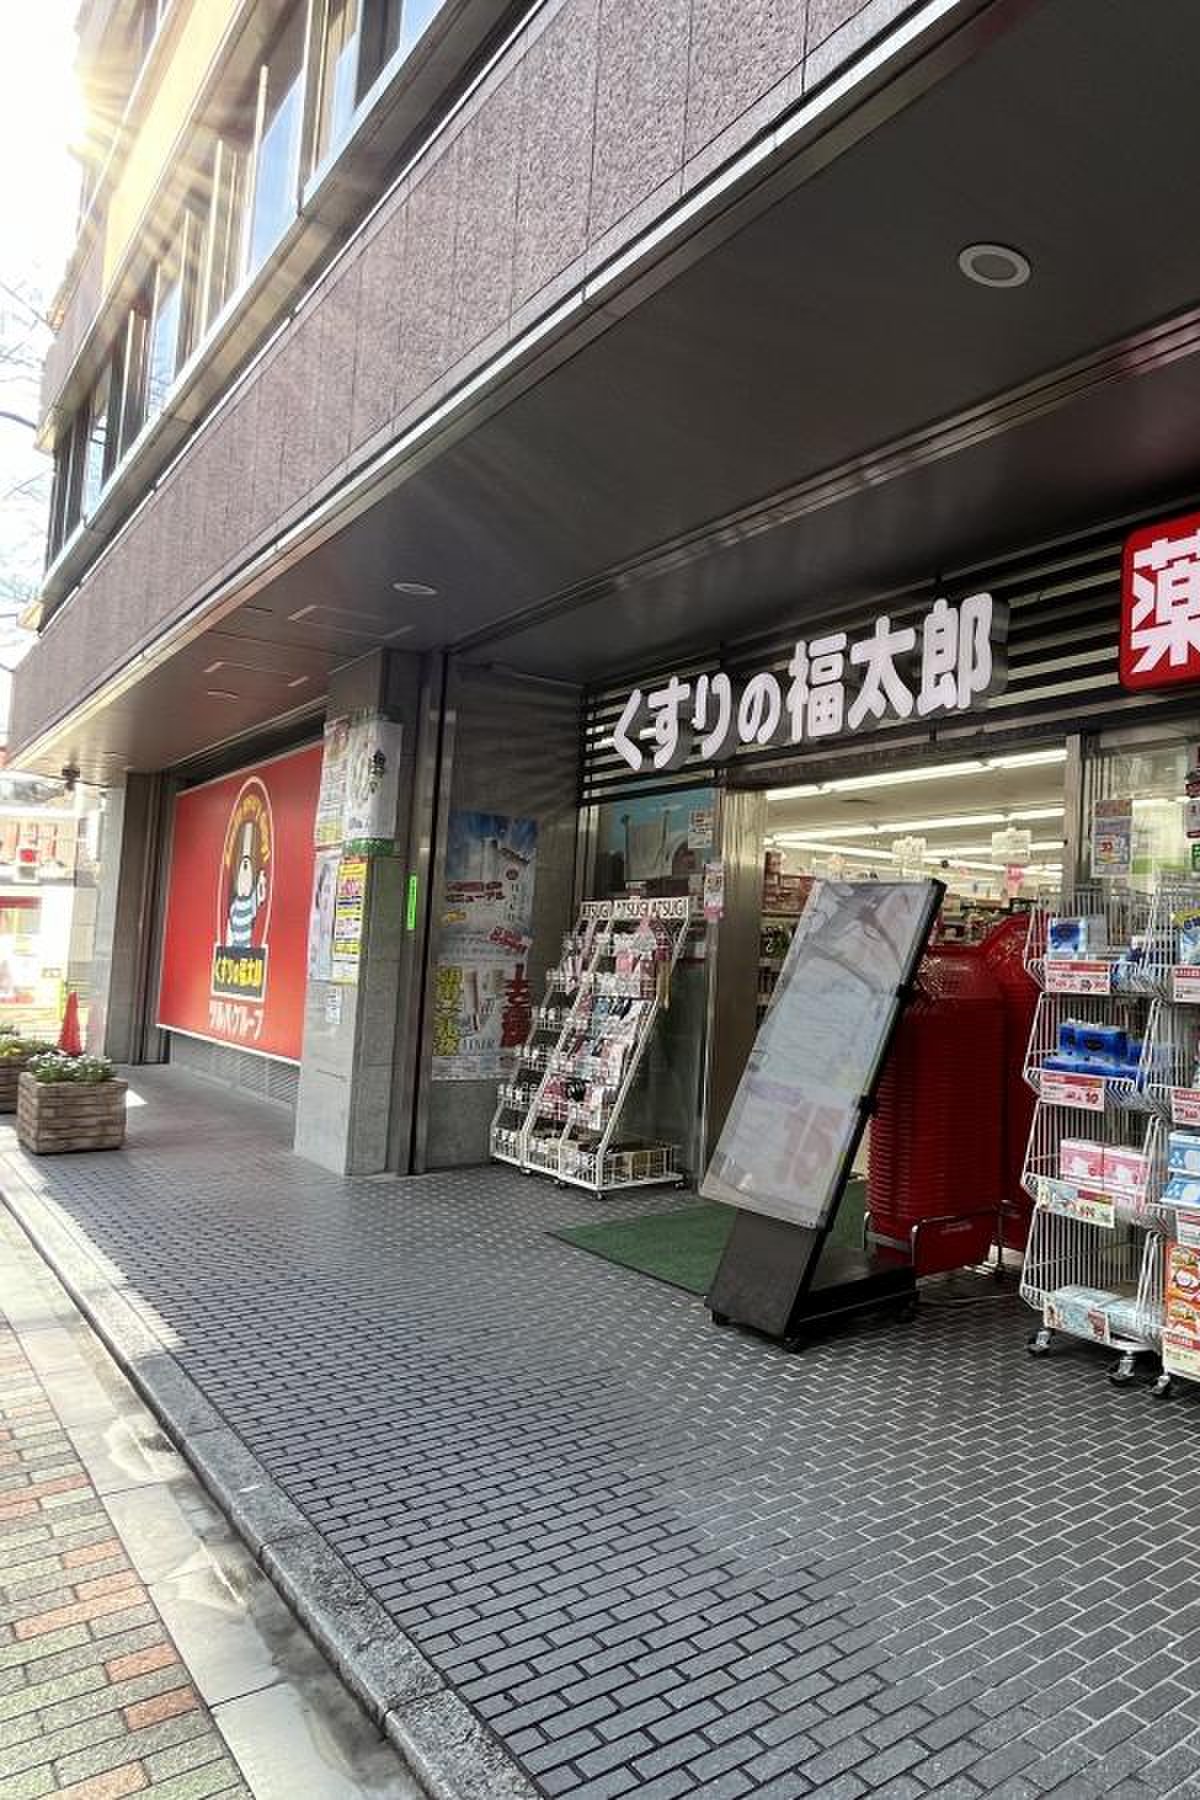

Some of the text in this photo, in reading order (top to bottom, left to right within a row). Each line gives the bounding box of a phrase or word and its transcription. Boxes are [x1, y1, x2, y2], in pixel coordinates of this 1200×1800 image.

[612, 592, 994, 771] くすりの福太郎
